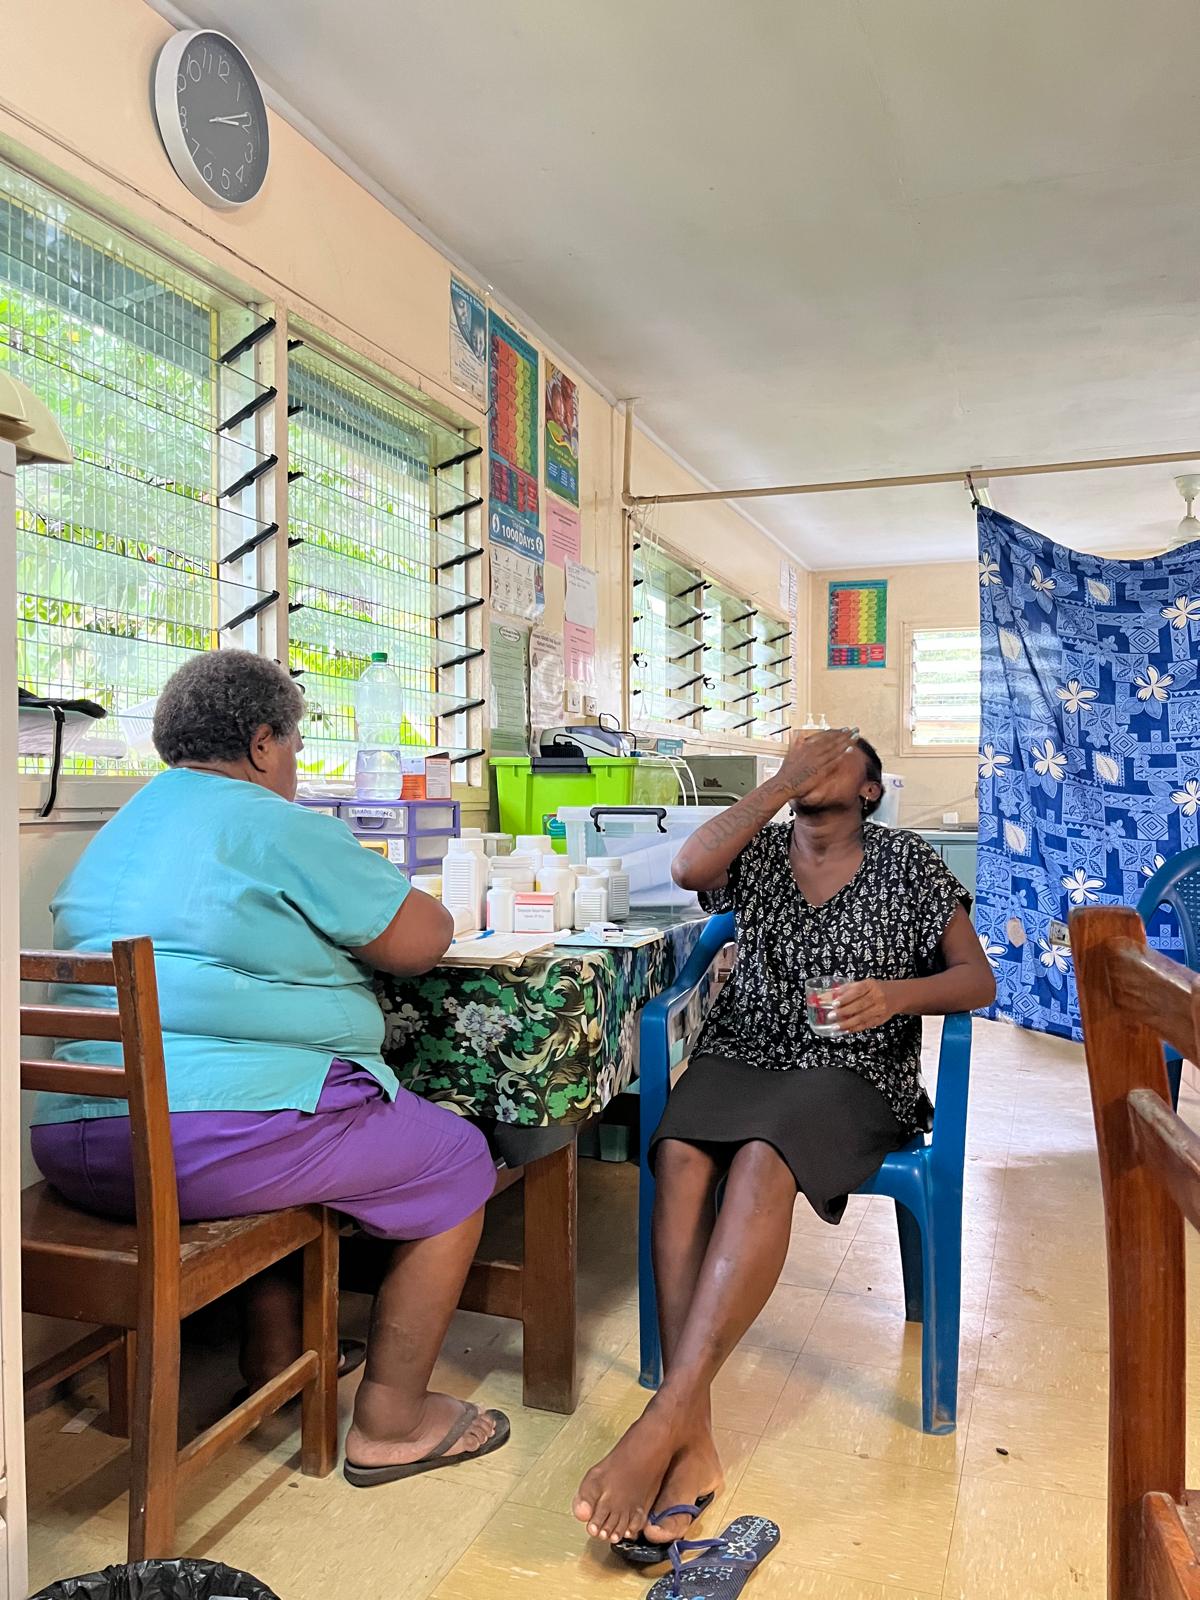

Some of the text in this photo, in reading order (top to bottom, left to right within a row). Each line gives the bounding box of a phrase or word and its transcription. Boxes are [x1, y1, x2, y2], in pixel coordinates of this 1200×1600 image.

[187, 54, 201, 82] 10
[203, 48, 213, 74] 11
[217, 55, 230, 84] 12
[179, 105, 187, 129] 8
[242, 111, 253, 134] 2
[191, 137, 200, 158] 7
[244, 142, 253, 163] 3
[203, 162, 213, 182] 6
[221, 167, 231, 190] 5
[235, 165, 244, 183] 4
